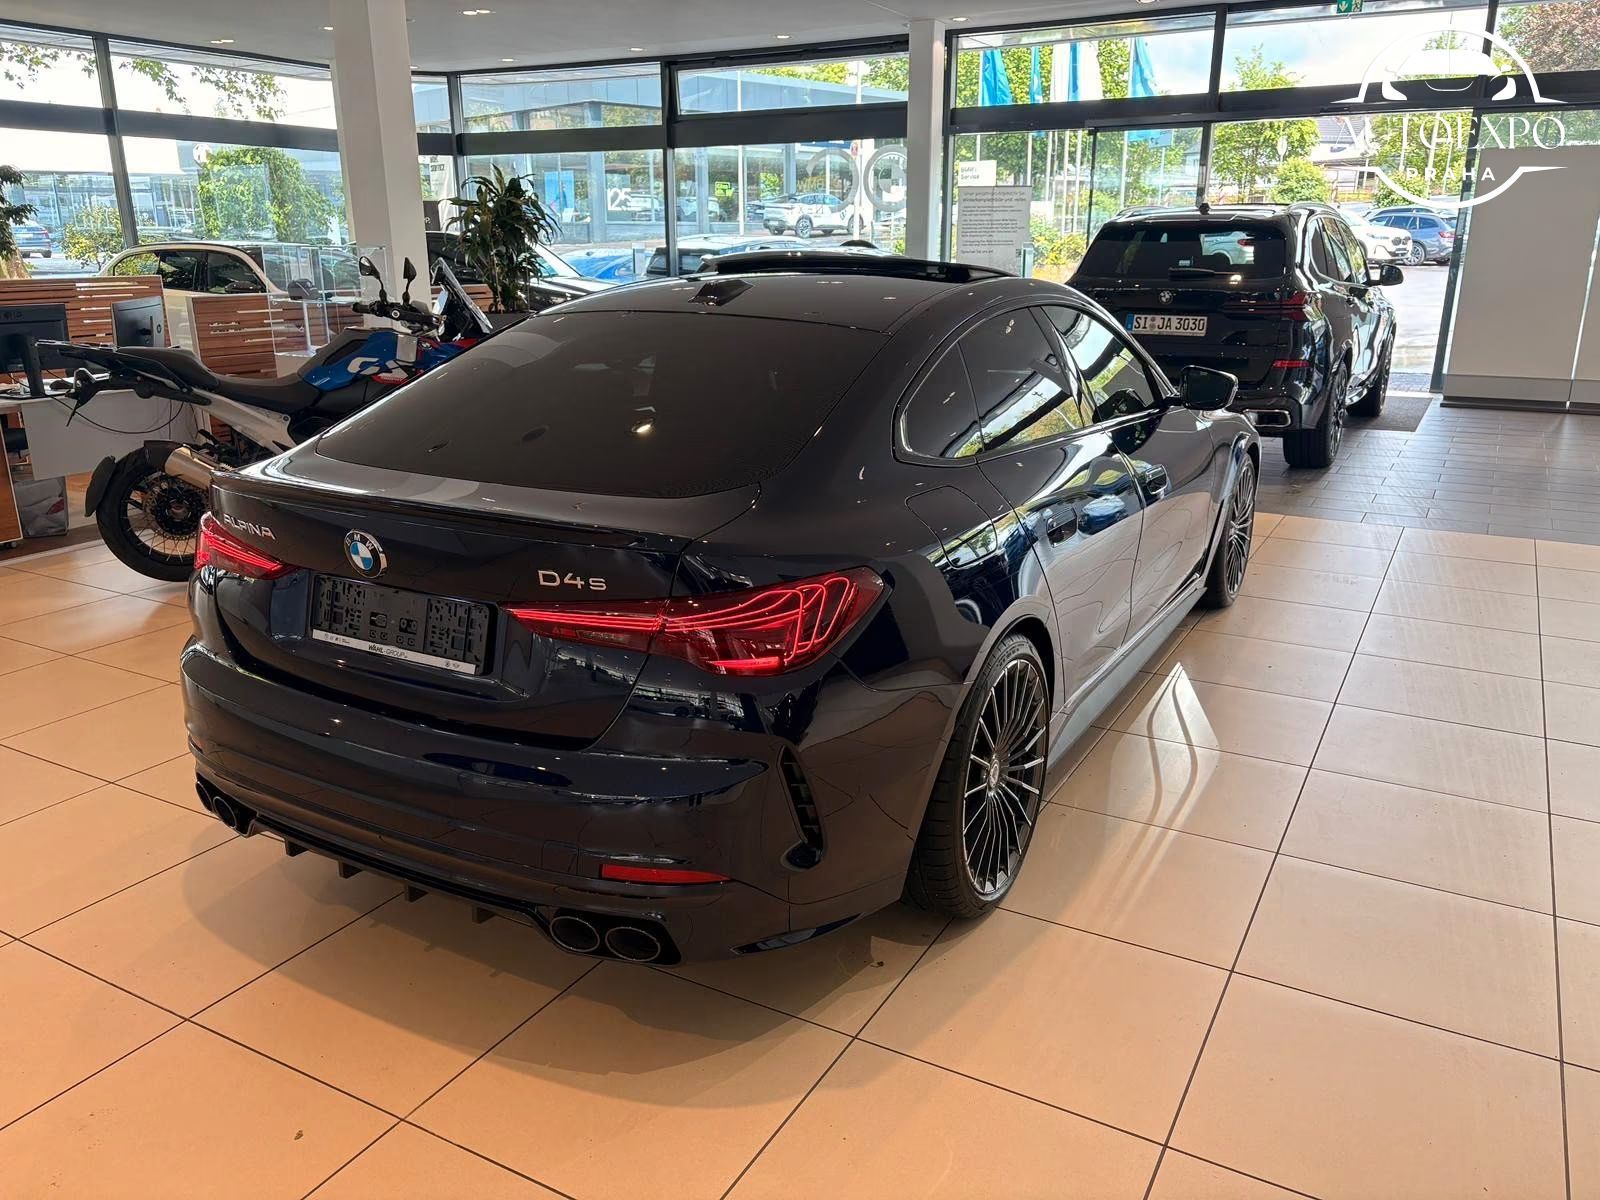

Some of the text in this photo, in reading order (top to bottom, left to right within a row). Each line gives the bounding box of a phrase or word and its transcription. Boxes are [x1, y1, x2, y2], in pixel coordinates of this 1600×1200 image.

[1134, 316, 1205, 331] SI JA 3030
[223, 513, 276, 540] ALPINA
